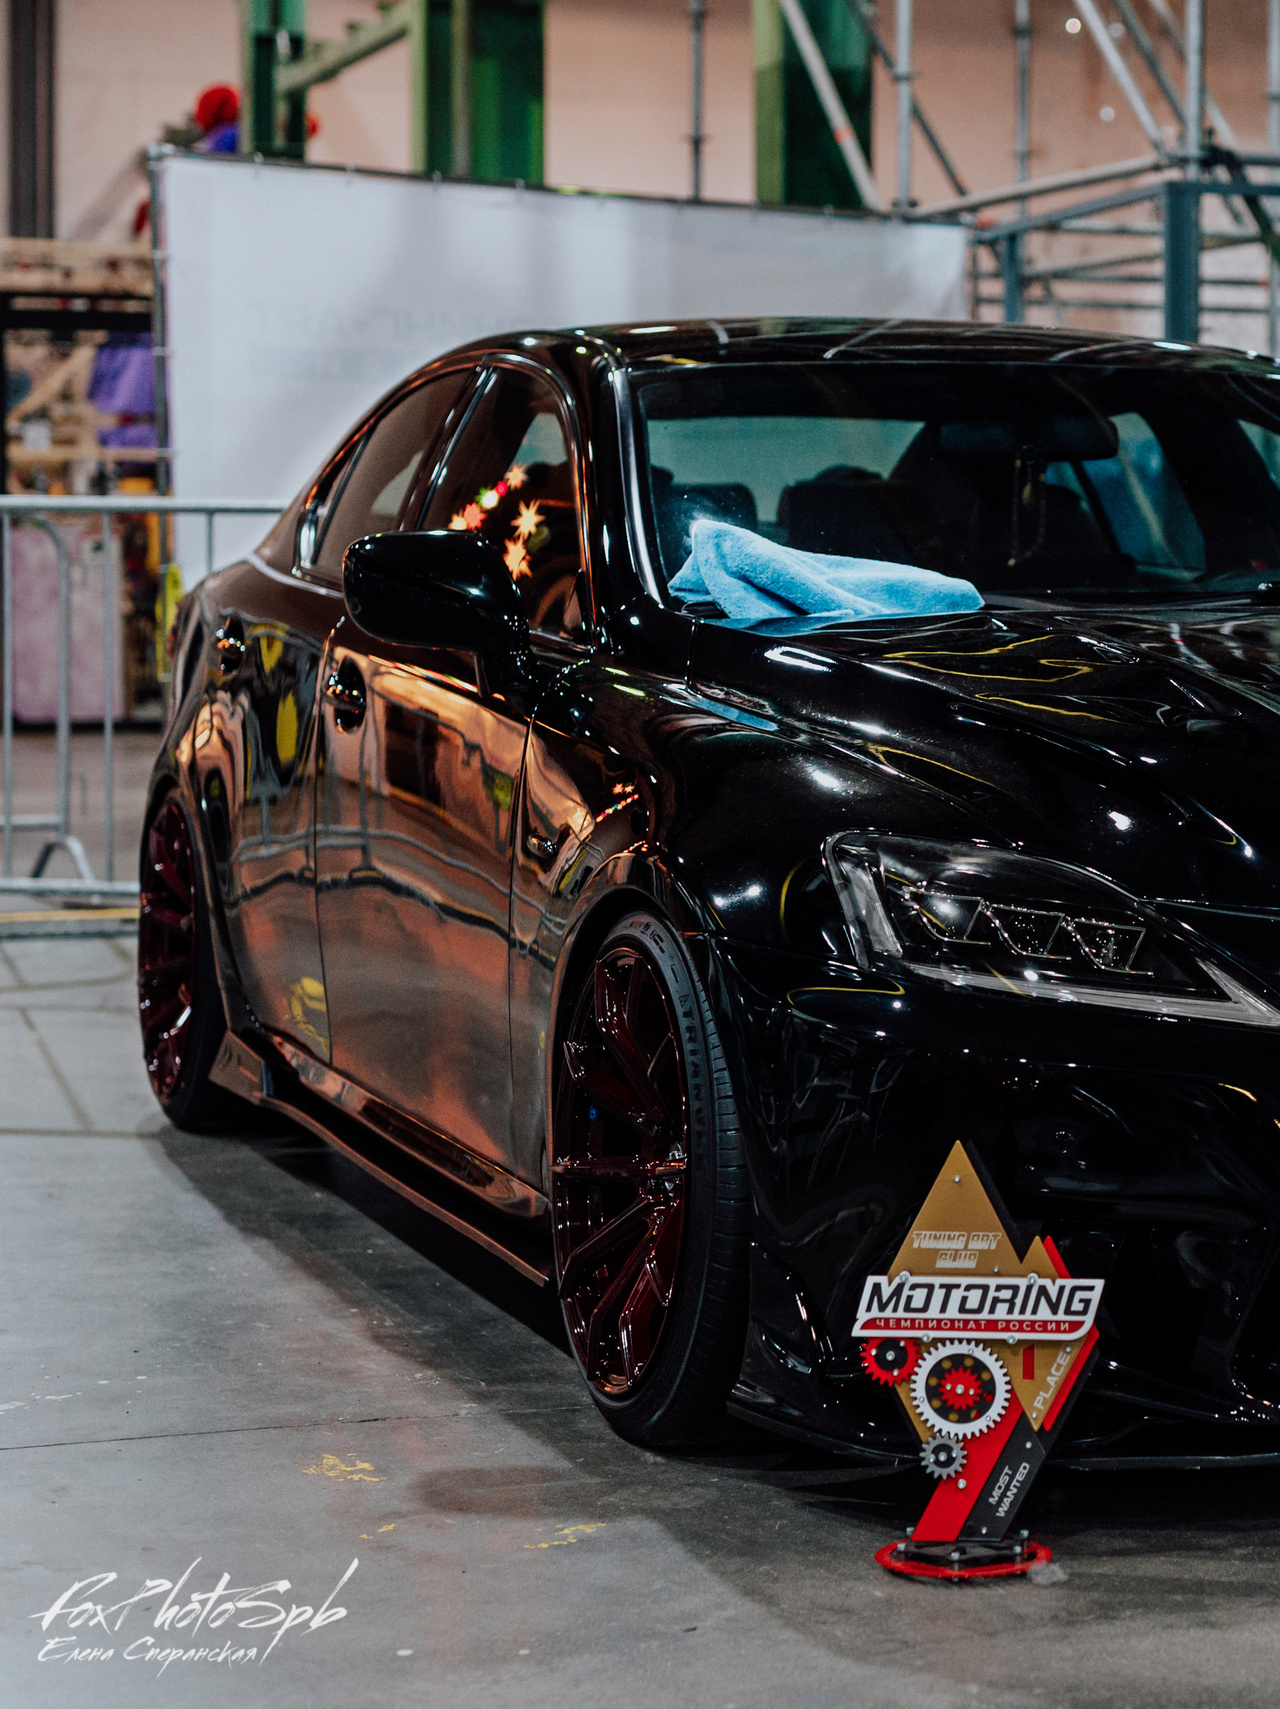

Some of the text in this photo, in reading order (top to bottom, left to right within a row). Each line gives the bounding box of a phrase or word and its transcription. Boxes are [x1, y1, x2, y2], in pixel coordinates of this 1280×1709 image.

[912, 1231, 1002, 1250] TUNING ART
[935, 1250, 979, 1269] CLUB
[865, 1282, 1096, 1317] MOTORING
[876, 1318, 1070, 1332] ЧЕМПИОНАТ РОССИИ
[1033, 1351, 1071, 1410] PLACE
[988, 1465, 1013, 1505] MOST
[996, 1462, 1030, 1518] WANTED
